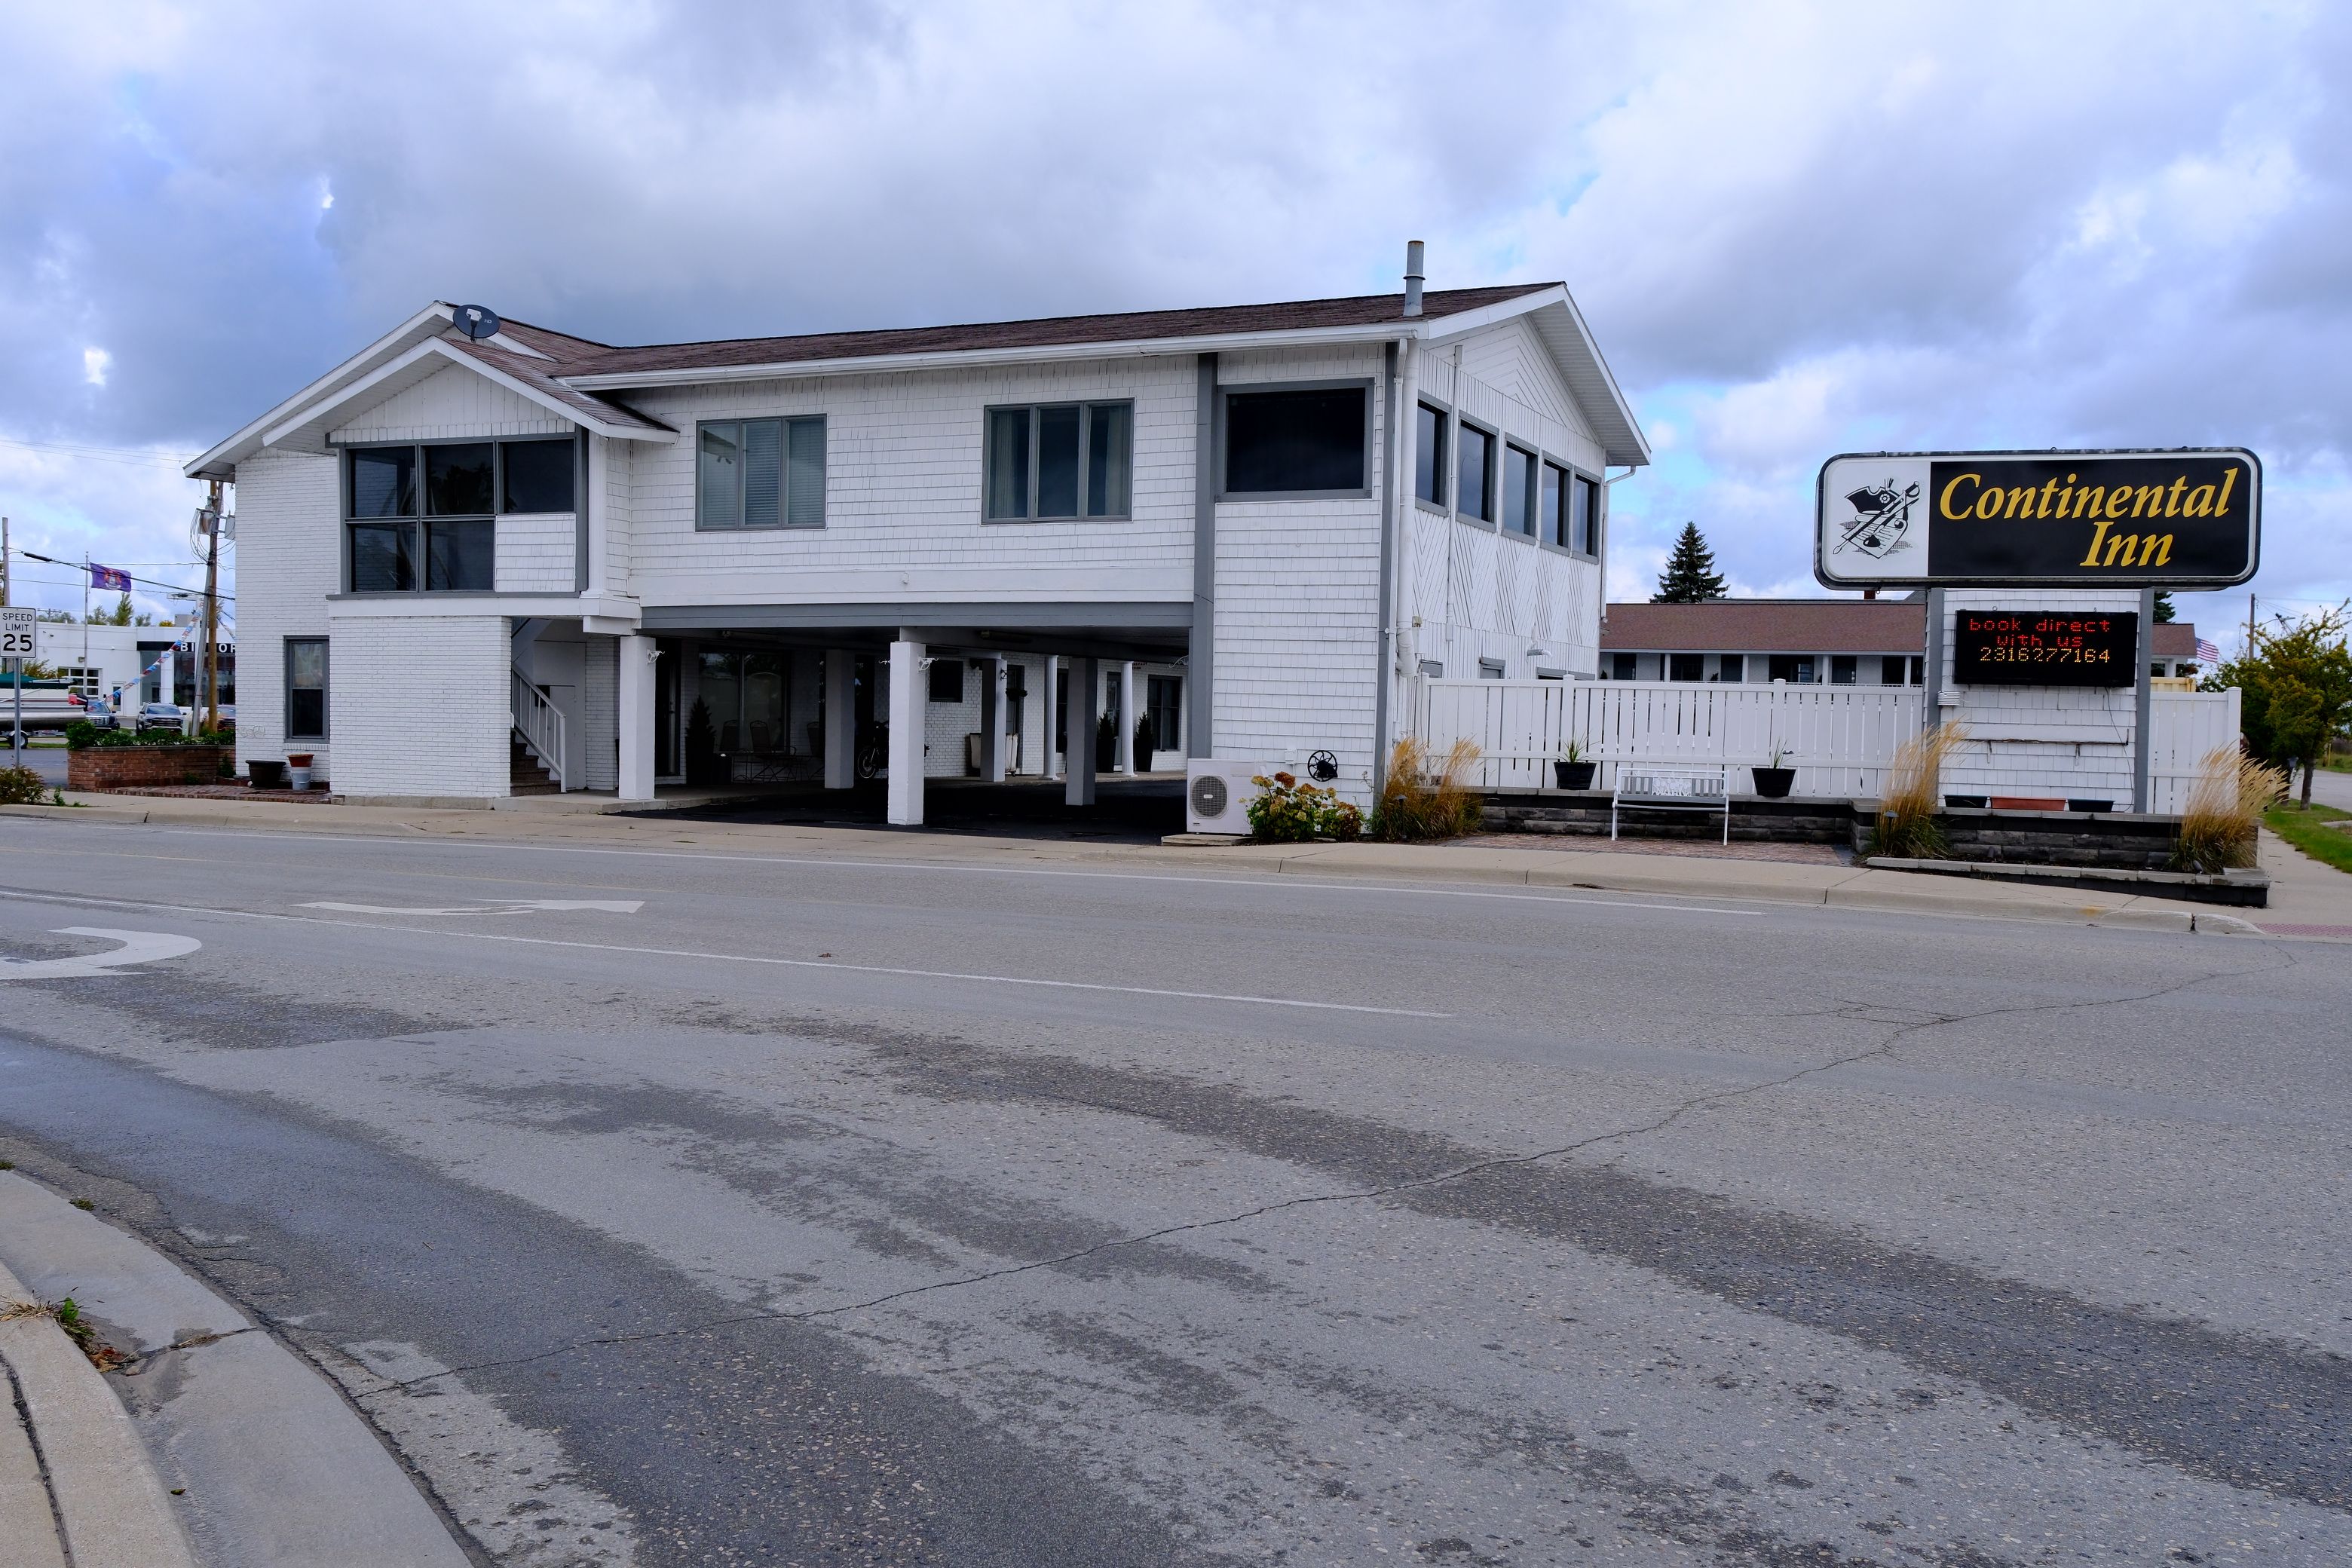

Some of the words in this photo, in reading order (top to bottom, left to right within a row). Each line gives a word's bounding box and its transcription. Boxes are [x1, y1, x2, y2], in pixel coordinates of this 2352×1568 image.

[1940, 467, 2238, 520] Continental
[2080, 521, 2173, 567] Inn
[2, 613, 33, 622] SPEED
[1969, 618, 2021, 631] book
[2035, 619, 2110, 632] direct
[5, 623, 30, 632] LIMIT
[3, 633, 32, 652] 25
[1997, 634, 2042, 646] with
[2057, 636, 2083, 647] us
[1980, 647, 2110, 663] 2316277164
